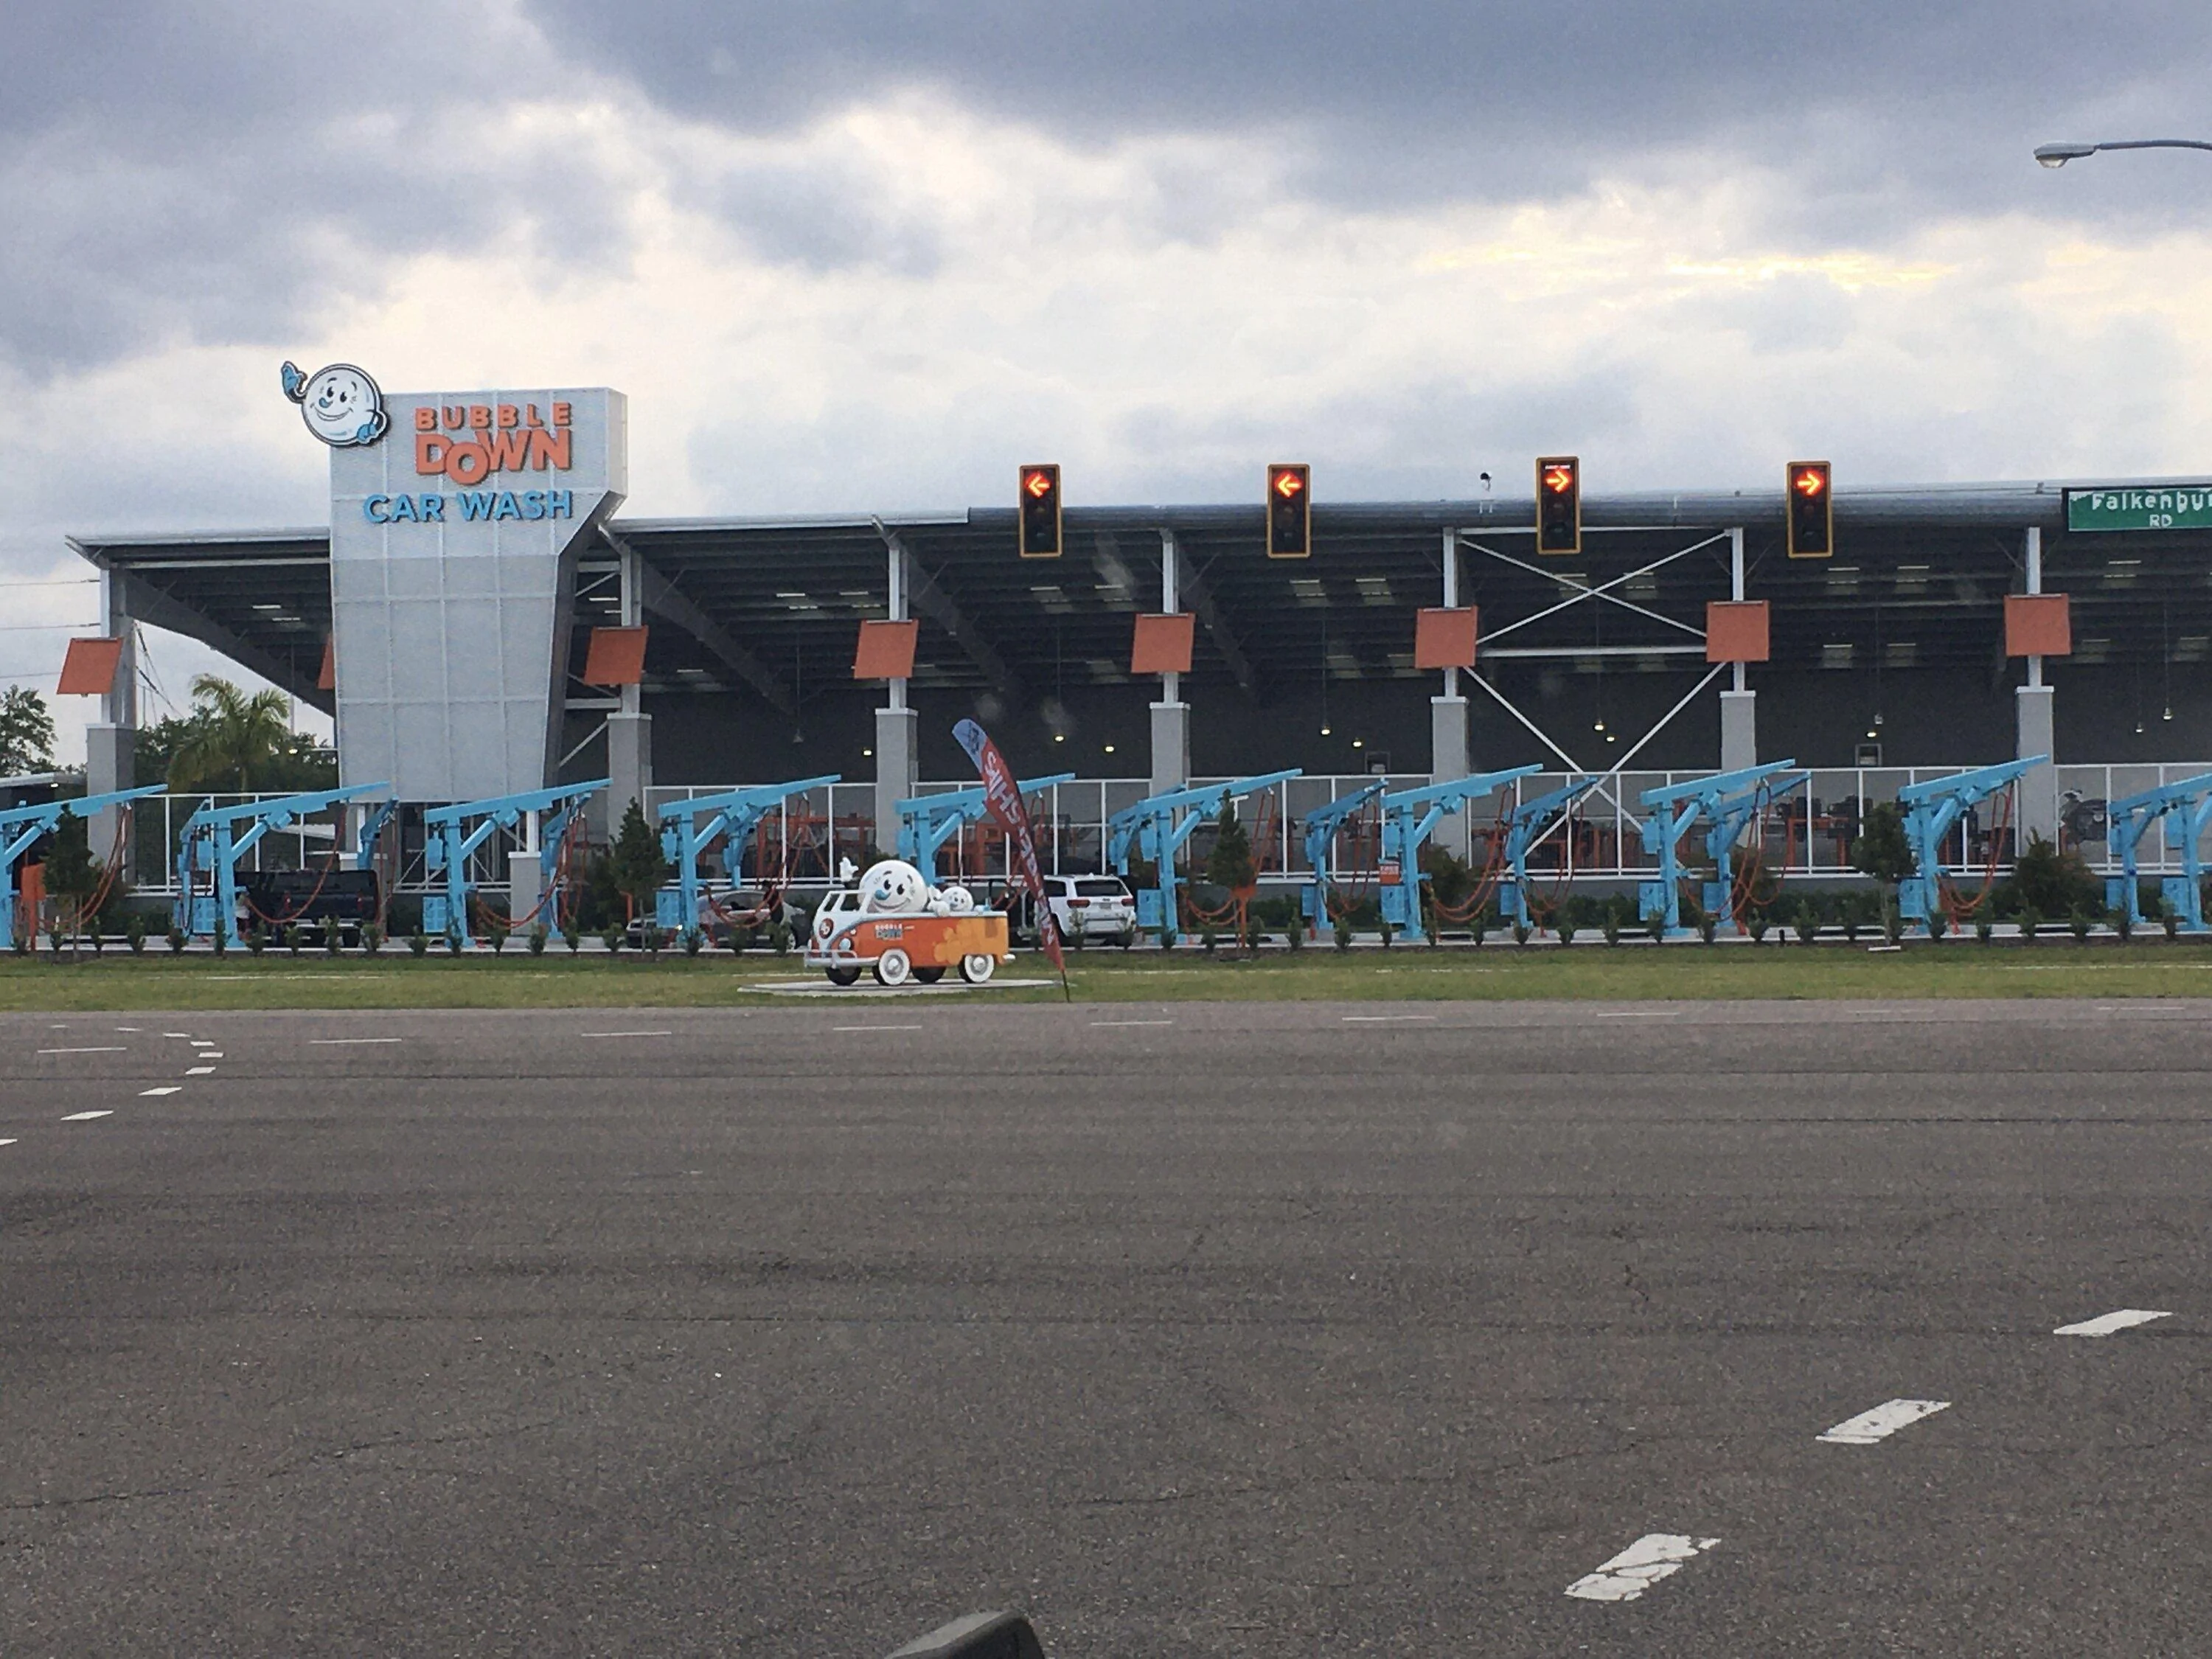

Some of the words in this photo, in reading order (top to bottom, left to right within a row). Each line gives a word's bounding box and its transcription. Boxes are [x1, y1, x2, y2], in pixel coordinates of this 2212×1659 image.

[415, 401, 571, 431] BUBBLE
[415, 428, 572, 486] DOWN
[364, 493, 444, 524] CAR
[457, 490, 573, 522] WASH
[2149, 514, 2172, 527] RD
